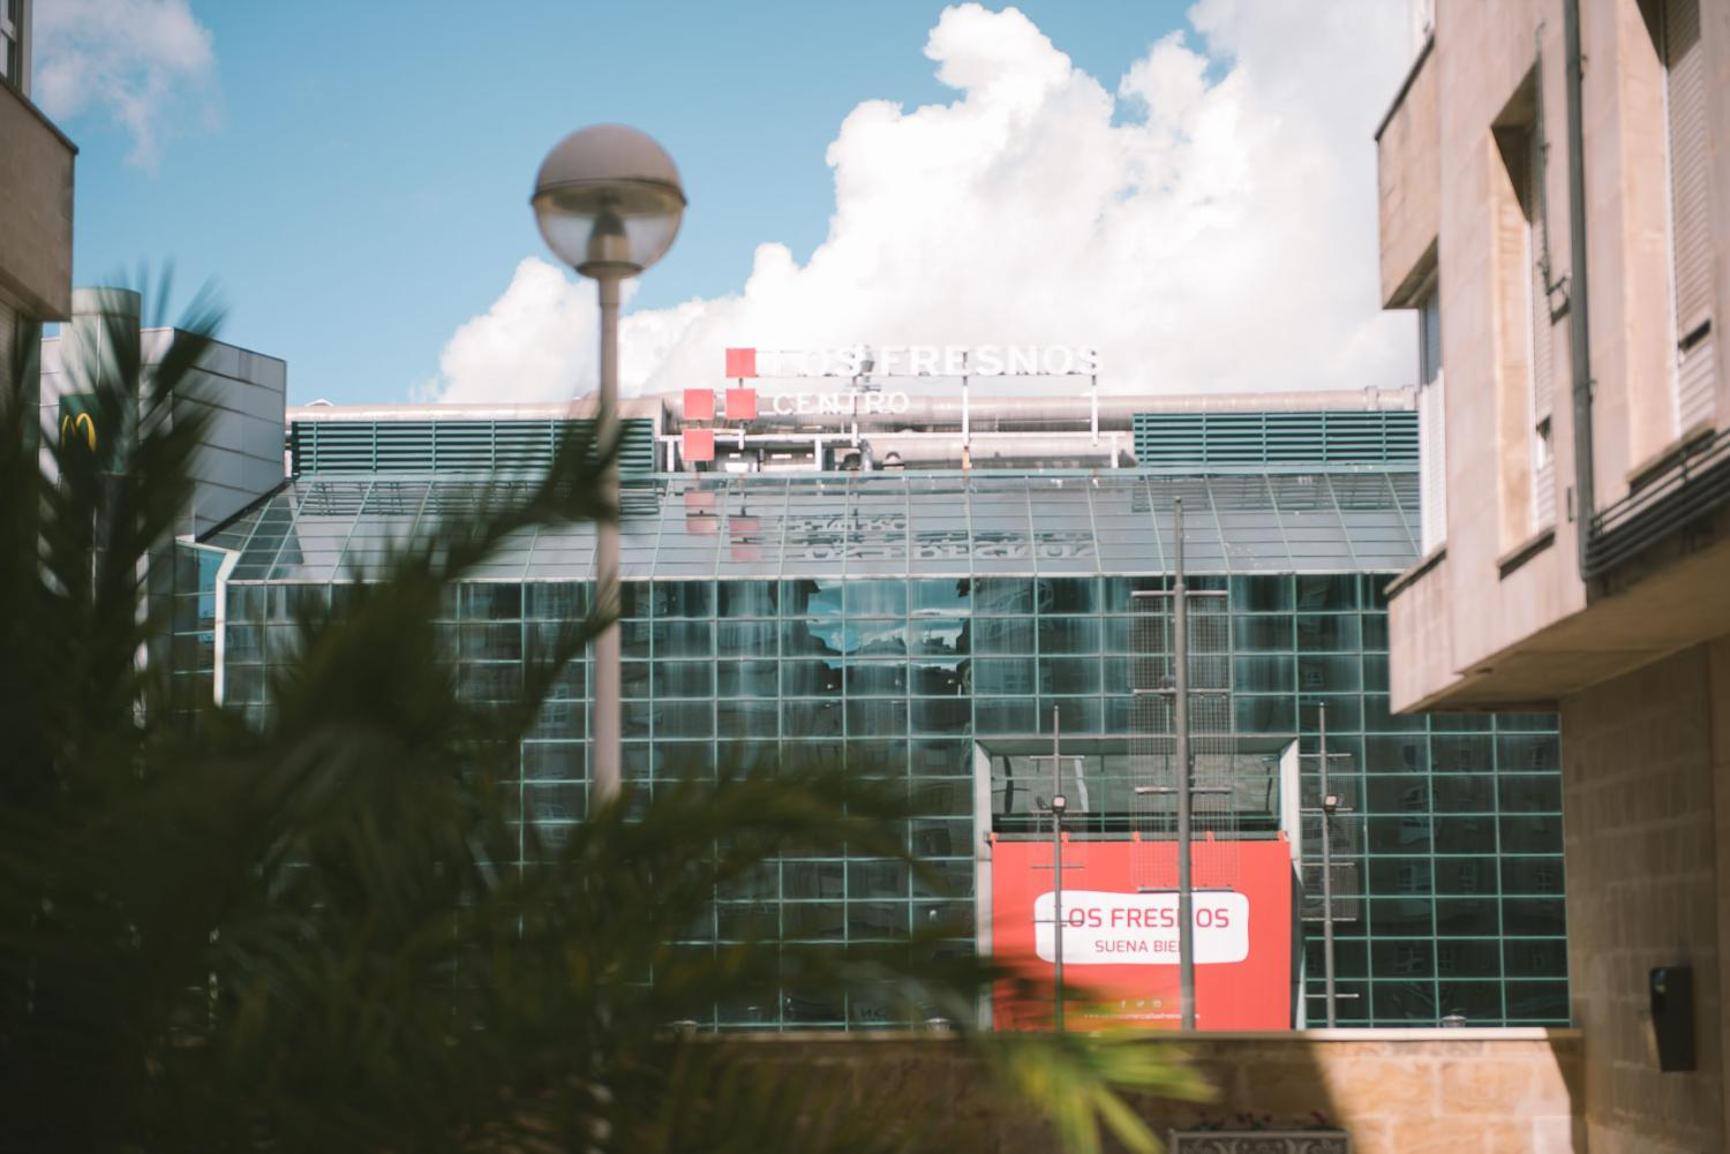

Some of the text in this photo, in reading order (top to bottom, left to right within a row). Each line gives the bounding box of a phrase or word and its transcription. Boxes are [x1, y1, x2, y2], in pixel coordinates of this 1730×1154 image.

[880, 344, 1103, 375] FRESNOS
[773, 392, 909, 414] CENTRO
[1111, 908, 1230, 928] FRESOS
[1095, 940, 1190, 953] SUENA BIE
